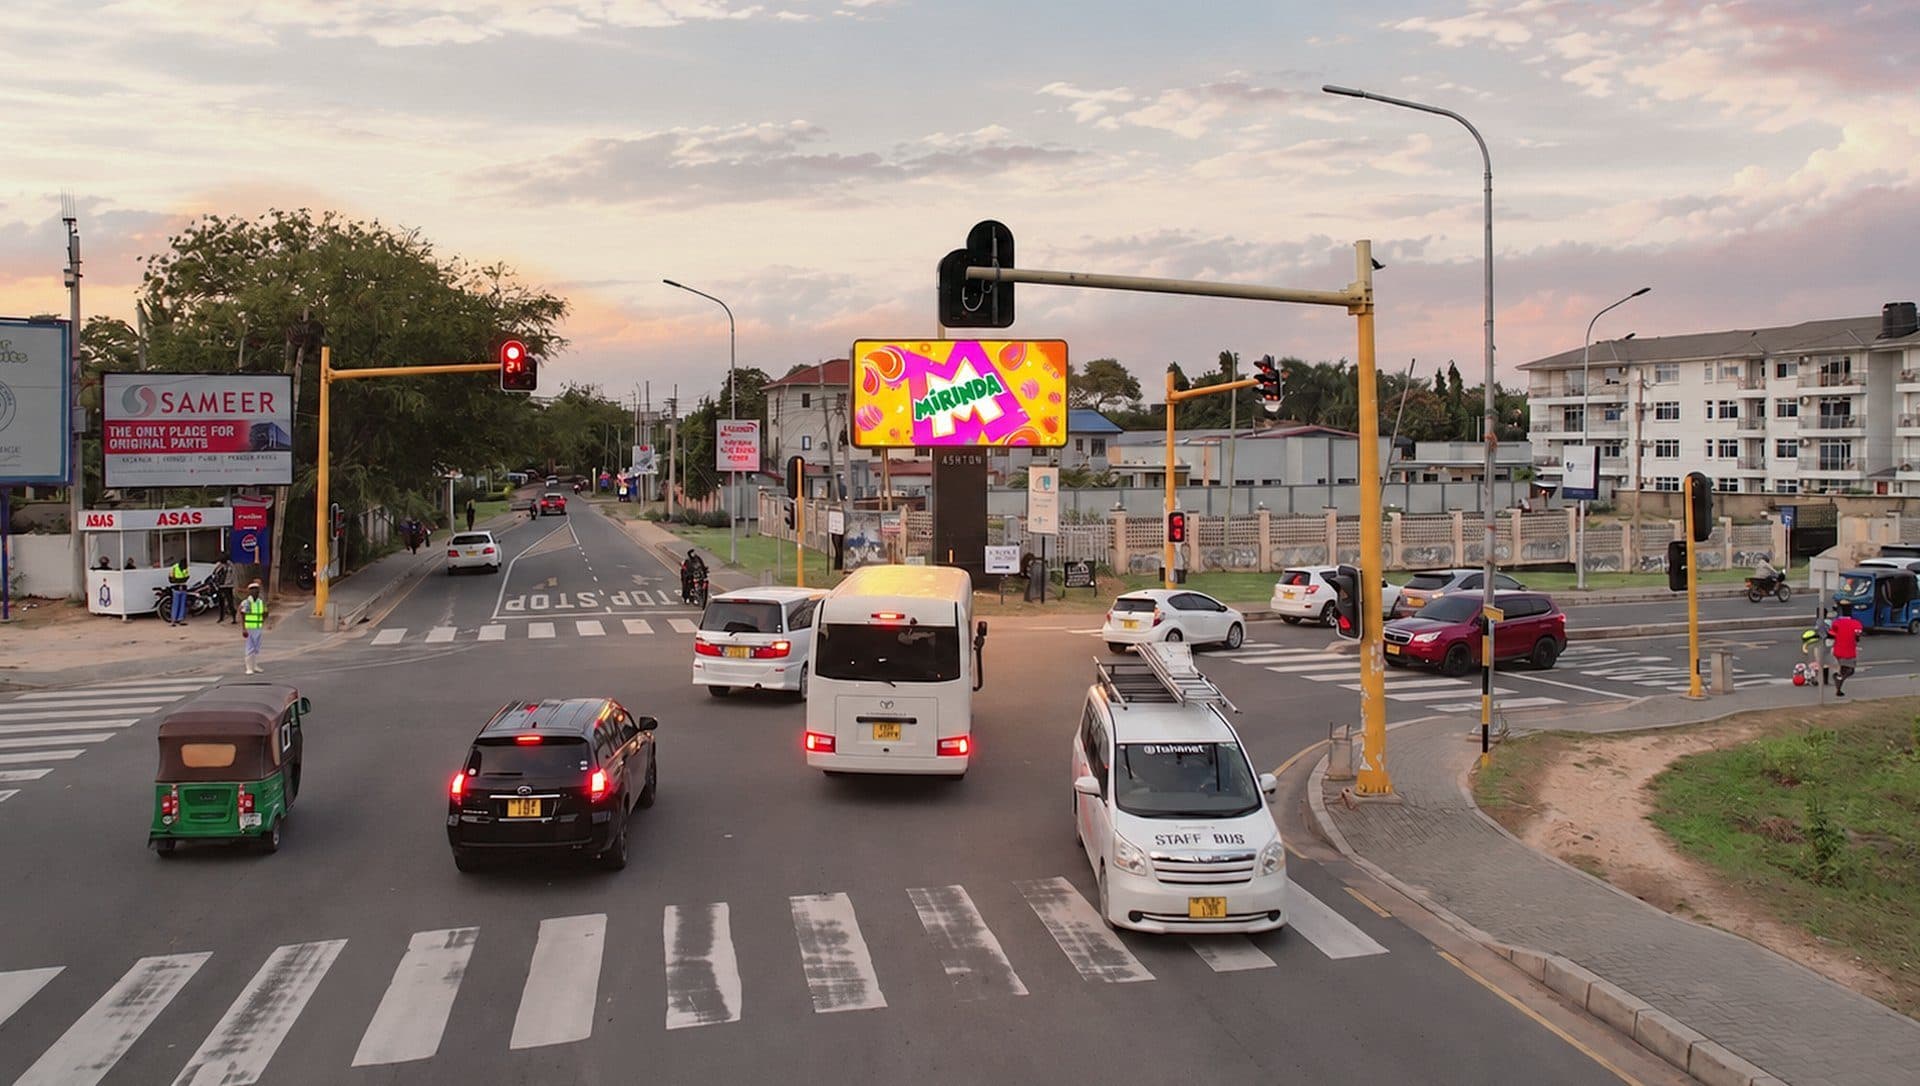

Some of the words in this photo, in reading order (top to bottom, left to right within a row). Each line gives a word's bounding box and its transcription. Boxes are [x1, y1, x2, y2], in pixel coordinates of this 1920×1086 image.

[161, 392, 275, 413] SAMEER
[109, 426, 132, 437] THE
[136, 426, 166, 438] ONLY
[169, 426, 207, 437] PLACE
[211, 425, 234, 437] FOR
[109, 437, 167, 450] ORIGINAL
[171, 438, 209, 449] PARTS
[941, 455, 982, 465] ASHTON
[86, 514, 114, 527] ASAS
[157, 511, 202, 526] ASAS
[1155, 833, 1201, 846] STAFF
[1213, 833, 1245, 845] BUS
